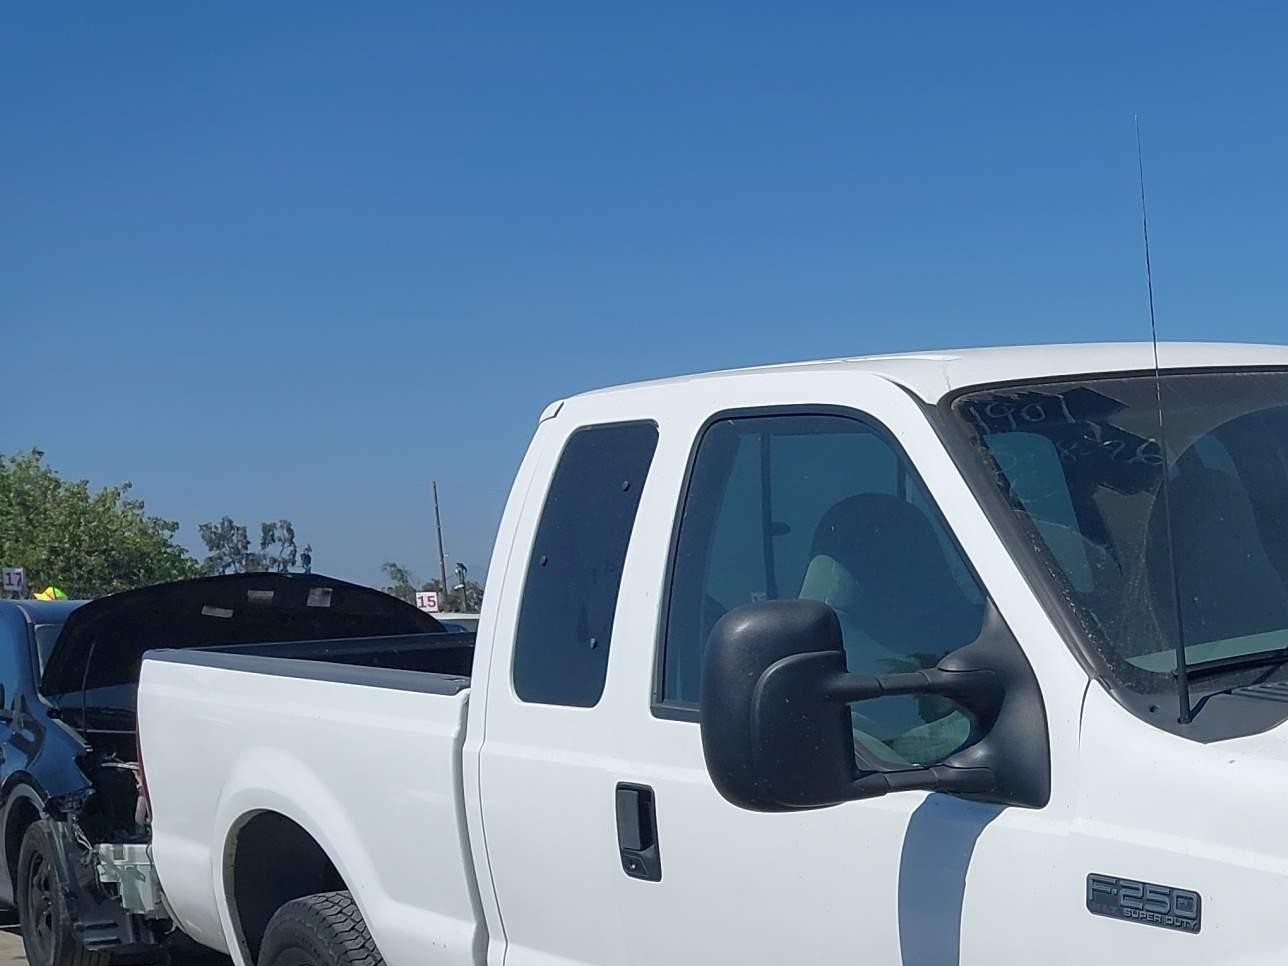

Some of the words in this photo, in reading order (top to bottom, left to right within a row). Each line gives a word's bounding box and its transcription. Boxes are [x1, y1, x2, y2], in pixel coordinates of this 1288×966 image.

[6, 572, 22, 587] 17
[418, 596, 436, 608] 15
[1123, 908, 1162, 923] SUPER
[1165, 916, 1198, 930] DUTY
